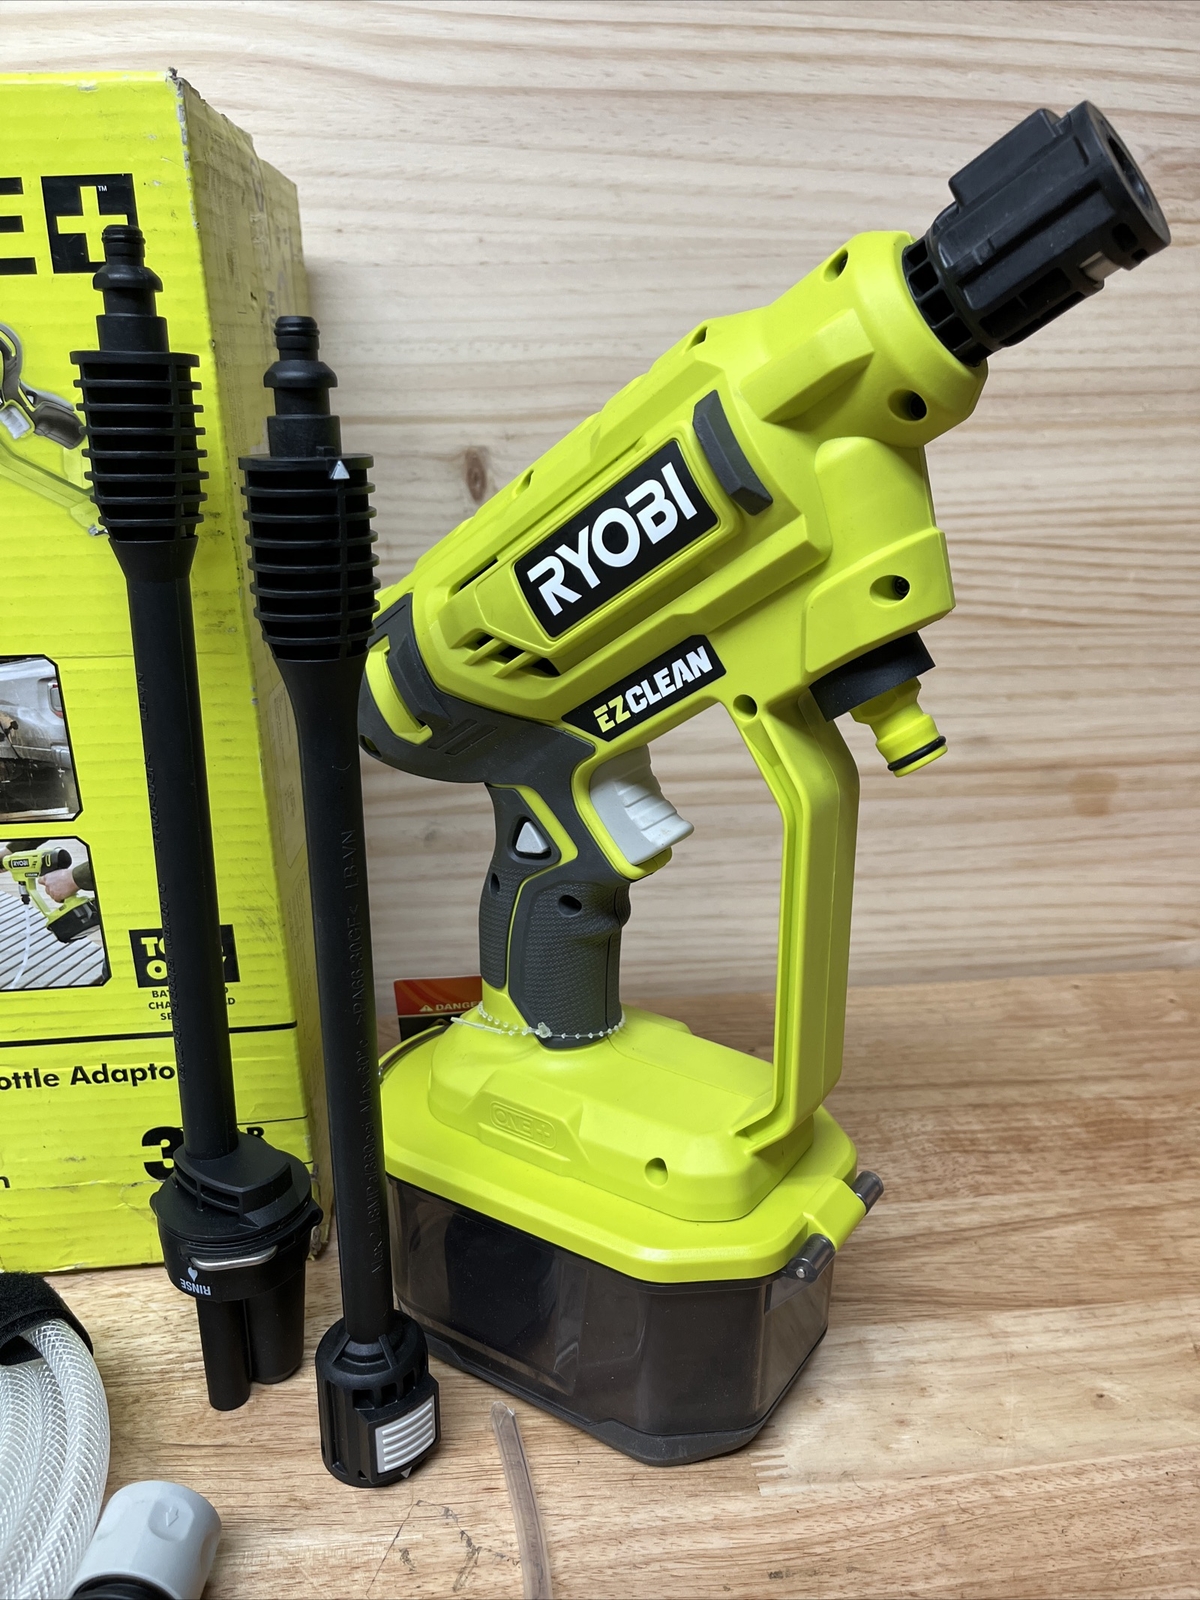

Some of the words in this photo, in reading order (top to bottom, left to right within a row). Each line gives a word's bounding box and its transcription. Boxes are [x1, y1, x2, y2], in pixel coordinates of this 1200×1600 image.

[527, 462, 698, 617] RYOBI
[593, 645, 713, 733] EZCLEAN
[436, 1001, 478, 1010] DANGE
[70, 1063, 176, 1087] Adapto
[180, 1278, 211, 1296] RINSE
